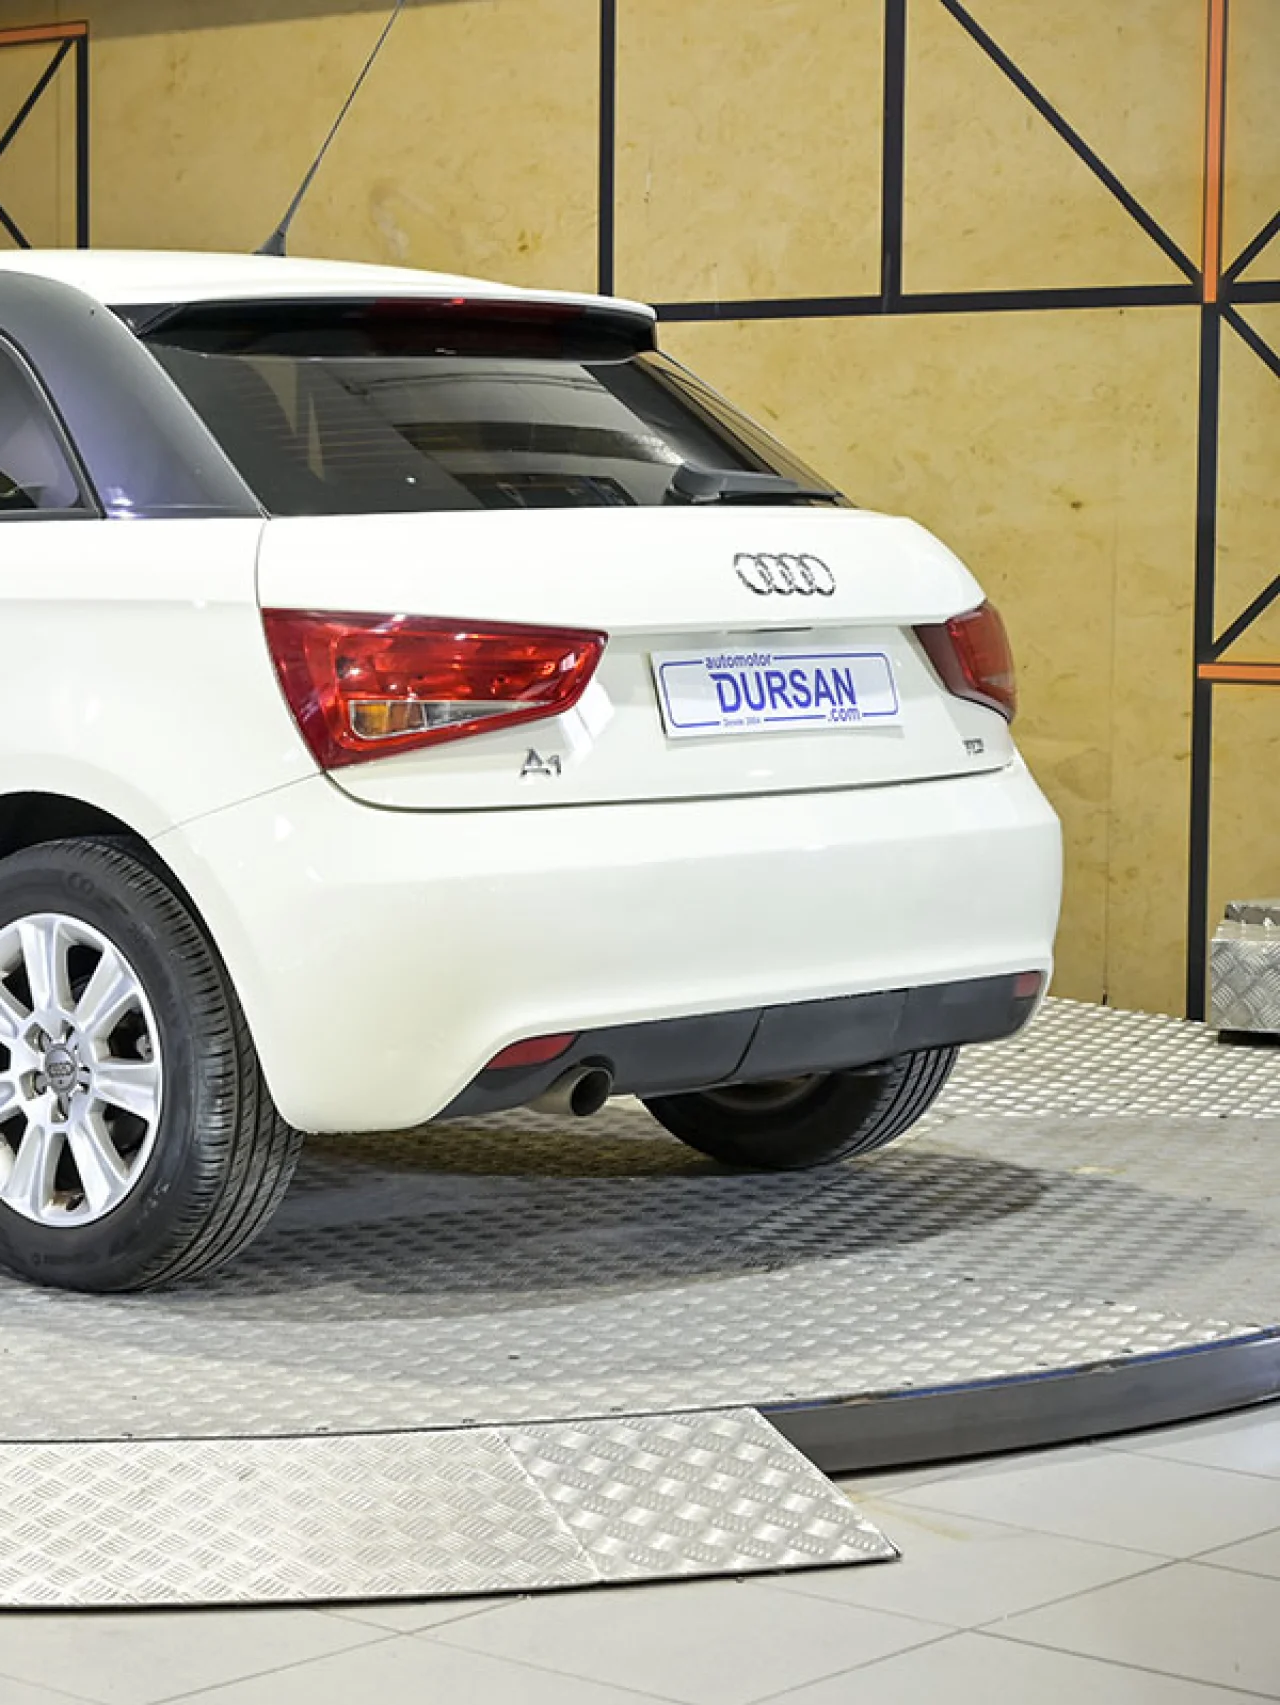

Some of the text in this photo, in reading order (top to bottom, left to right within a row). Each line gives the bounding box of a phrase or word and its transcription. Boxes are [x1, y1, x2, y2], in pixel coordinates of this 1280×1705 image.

[705, 653, 771, 669] automotor
[709, 667, 857, 713] DURSAN
[520, 747, 562, 777] A1
